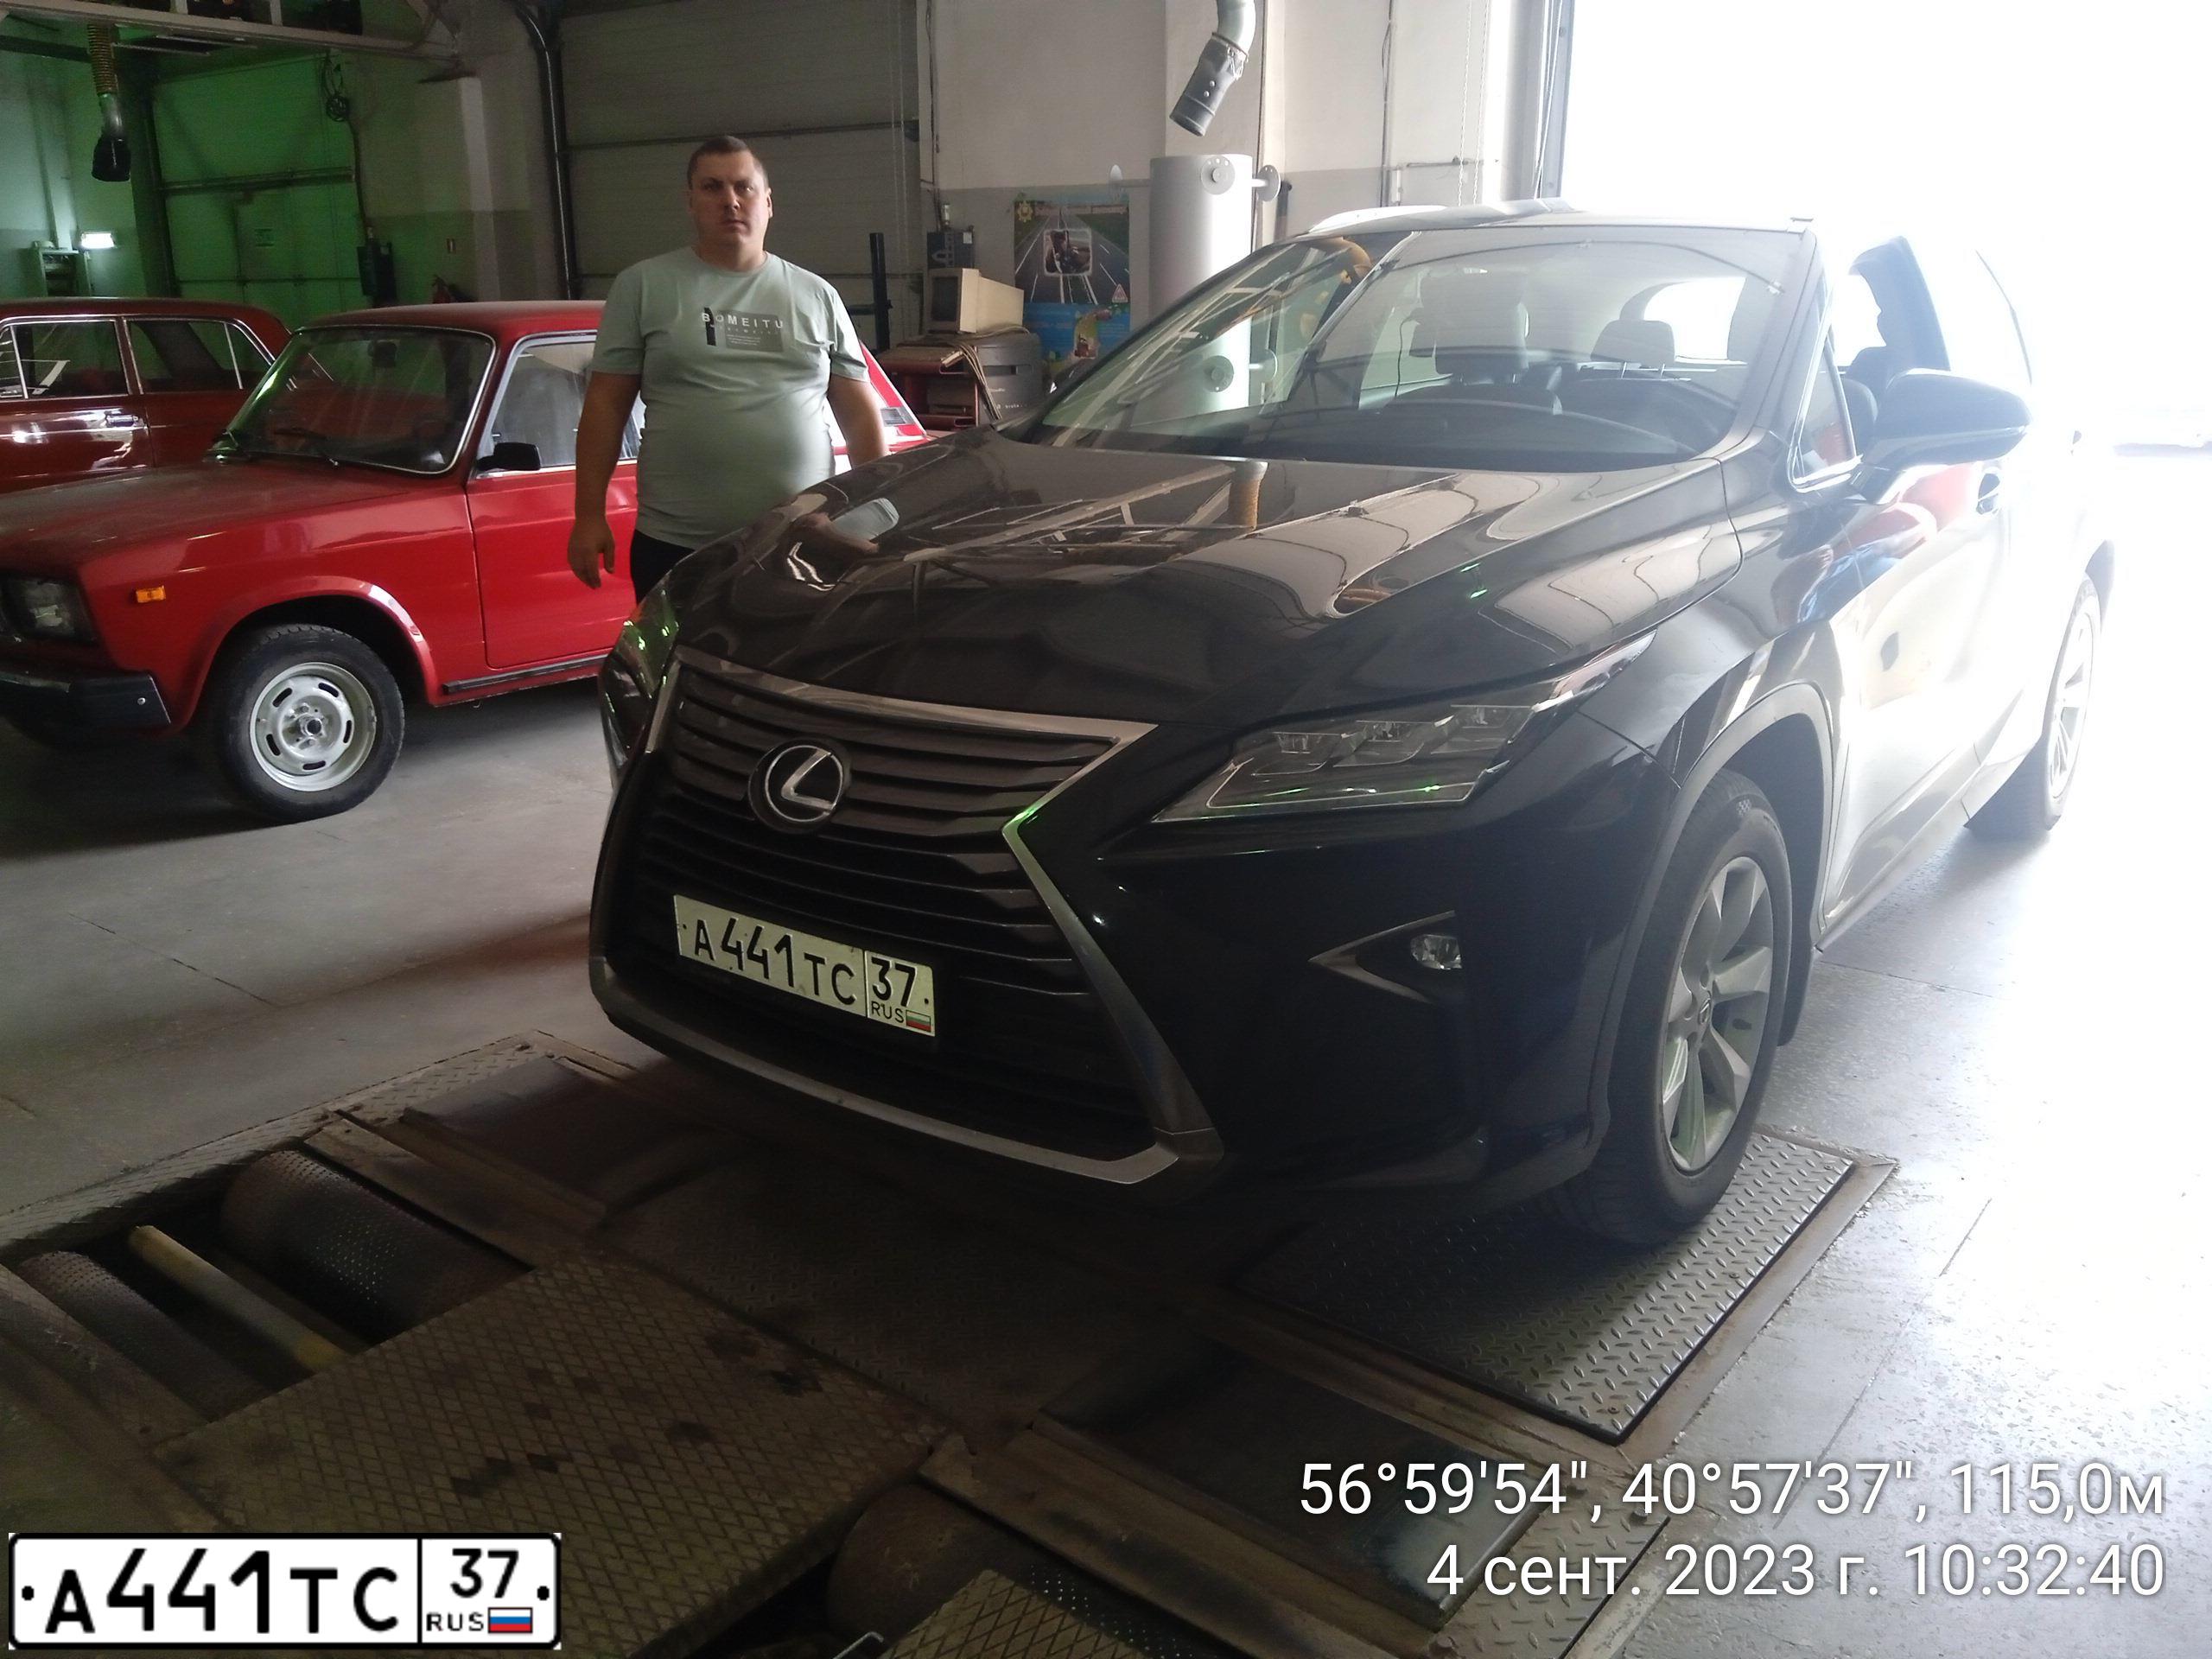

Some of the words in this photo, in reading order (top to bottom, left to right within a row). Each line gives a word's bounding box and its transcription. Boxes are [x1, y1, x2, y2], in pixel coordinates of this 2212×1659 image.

[702, 312, 784, 329] BOMEITU
[694, 917, 856, 1006] А441ТС
[871, 956, 917, 1007] 37
[871, 1001, 905, 1025] RUS
